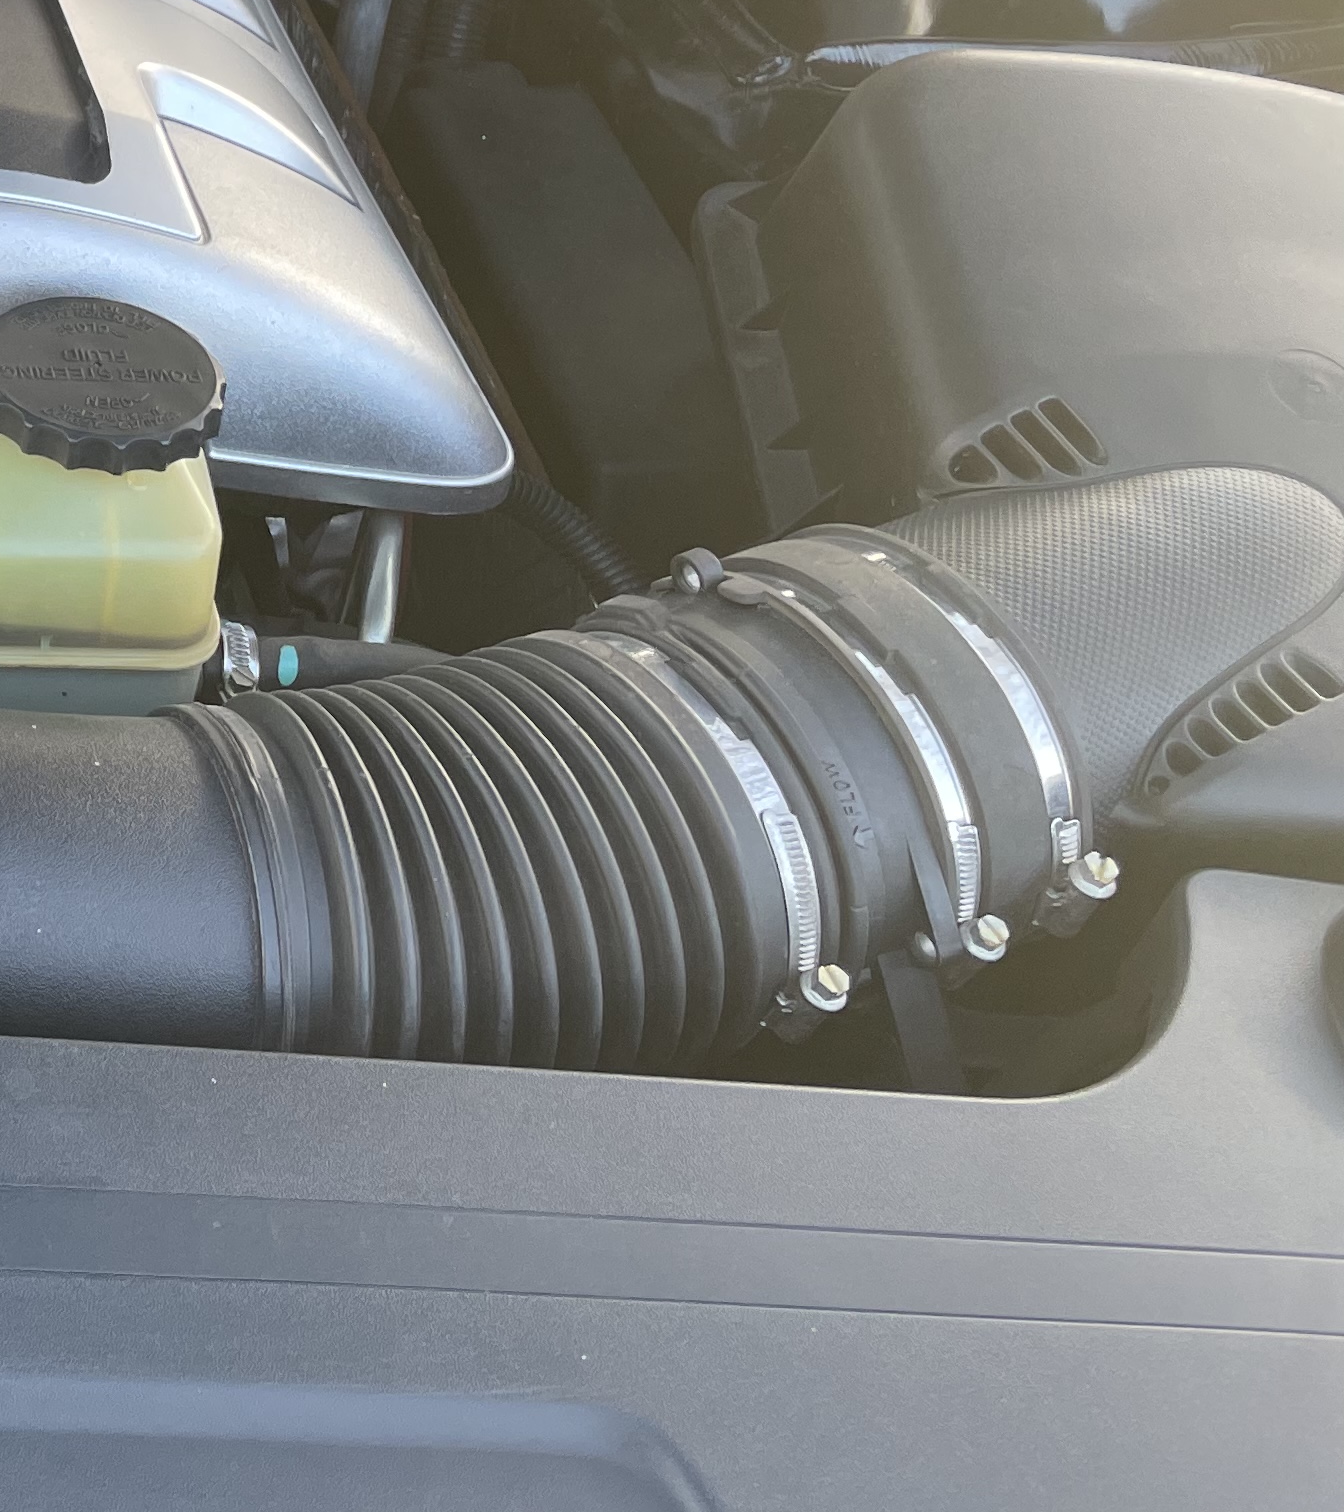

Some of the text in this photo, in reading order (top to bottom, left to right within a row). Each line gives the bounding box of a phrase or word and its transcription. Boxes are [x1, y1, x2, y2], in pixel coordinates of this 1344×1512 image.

[62, 346, 129, 363] FLUID
[0, 363, 205, 384] POWER STEERING
[85, 394, 135, 409] OPEN
